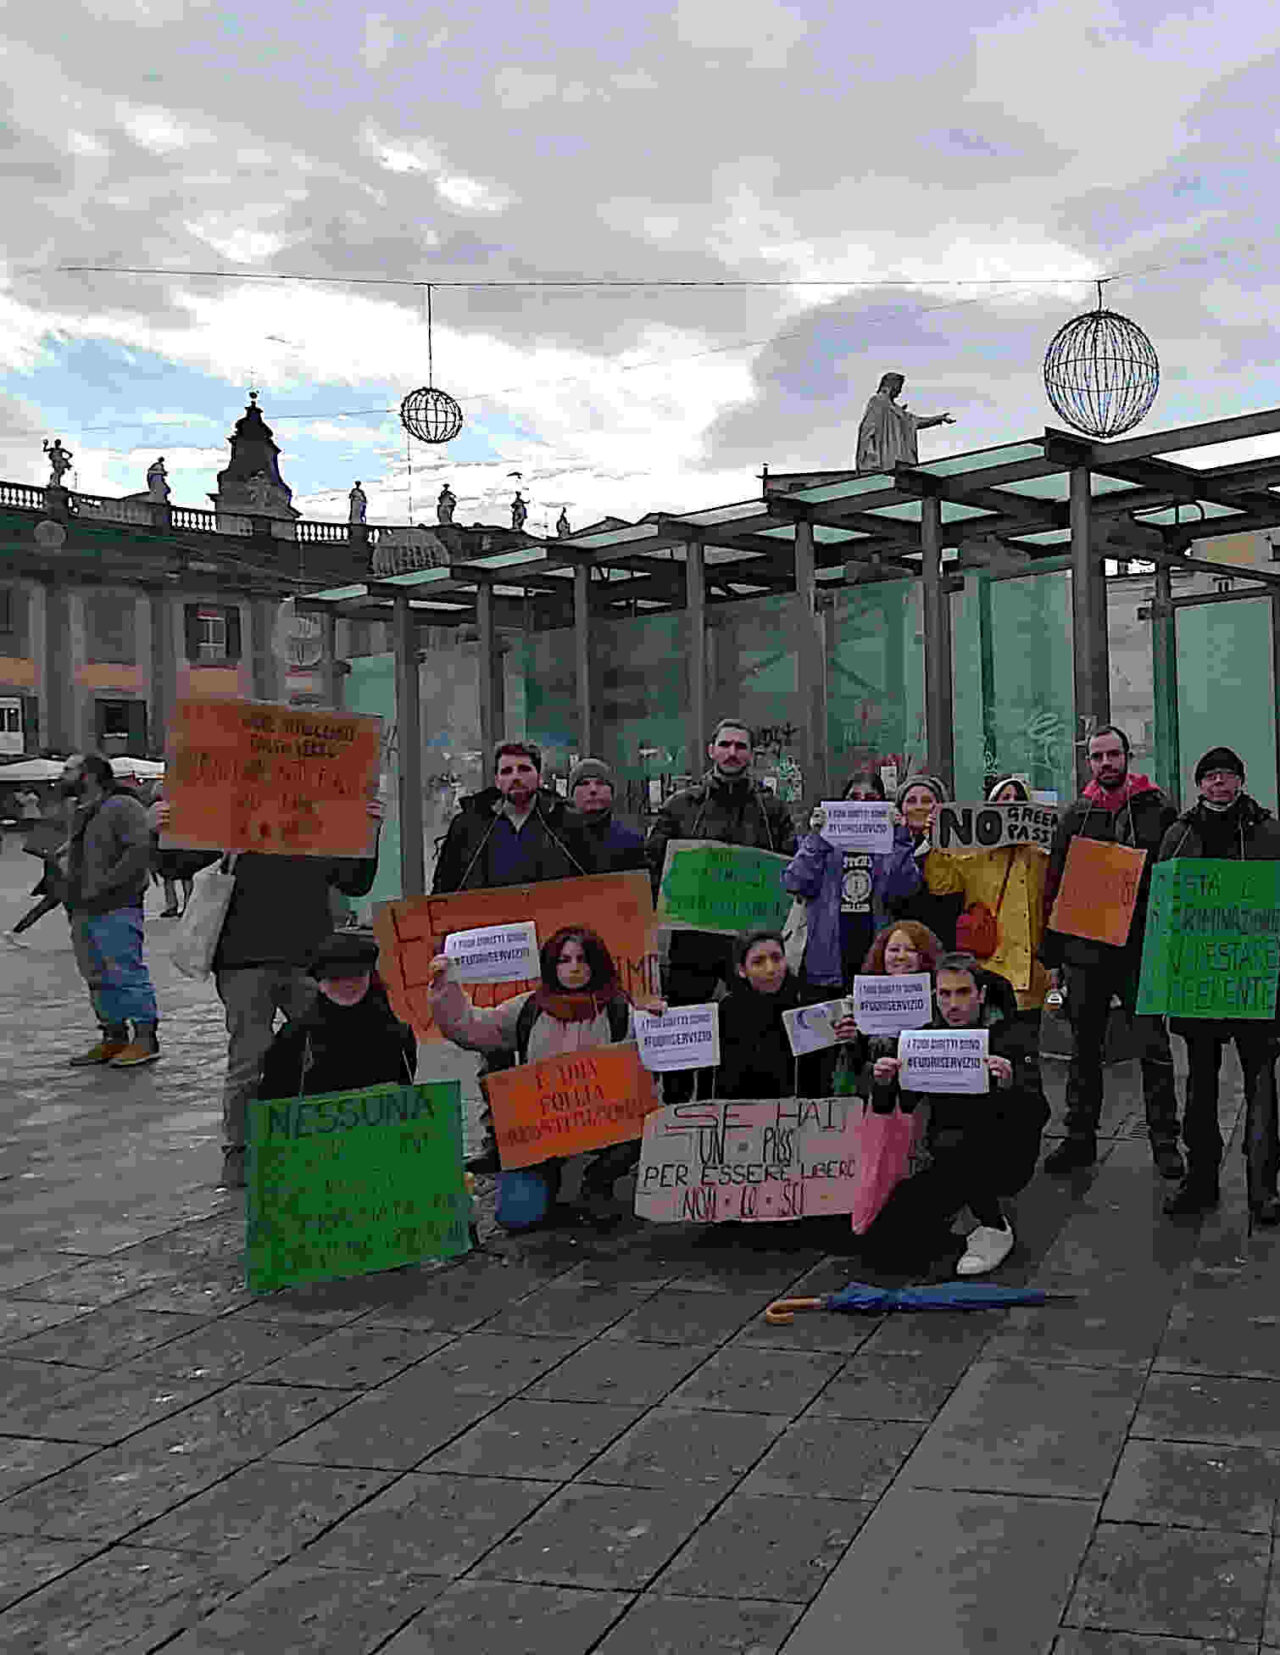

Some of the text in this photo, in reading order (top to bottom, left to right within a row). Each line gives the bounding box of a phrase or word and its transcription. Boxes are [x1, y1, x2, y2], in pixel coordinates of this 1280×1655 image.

[940, 808, 1002, 848] NO
[267, 1090, 436, 1140] NESSUNA
[665, 1097, 845, 1131] SE HAI
[698, 1126, 796, 1164] UN PASS
[643, 1163, 689, 1188] PER
[699, 1163, 792, 1187] ESSERE
